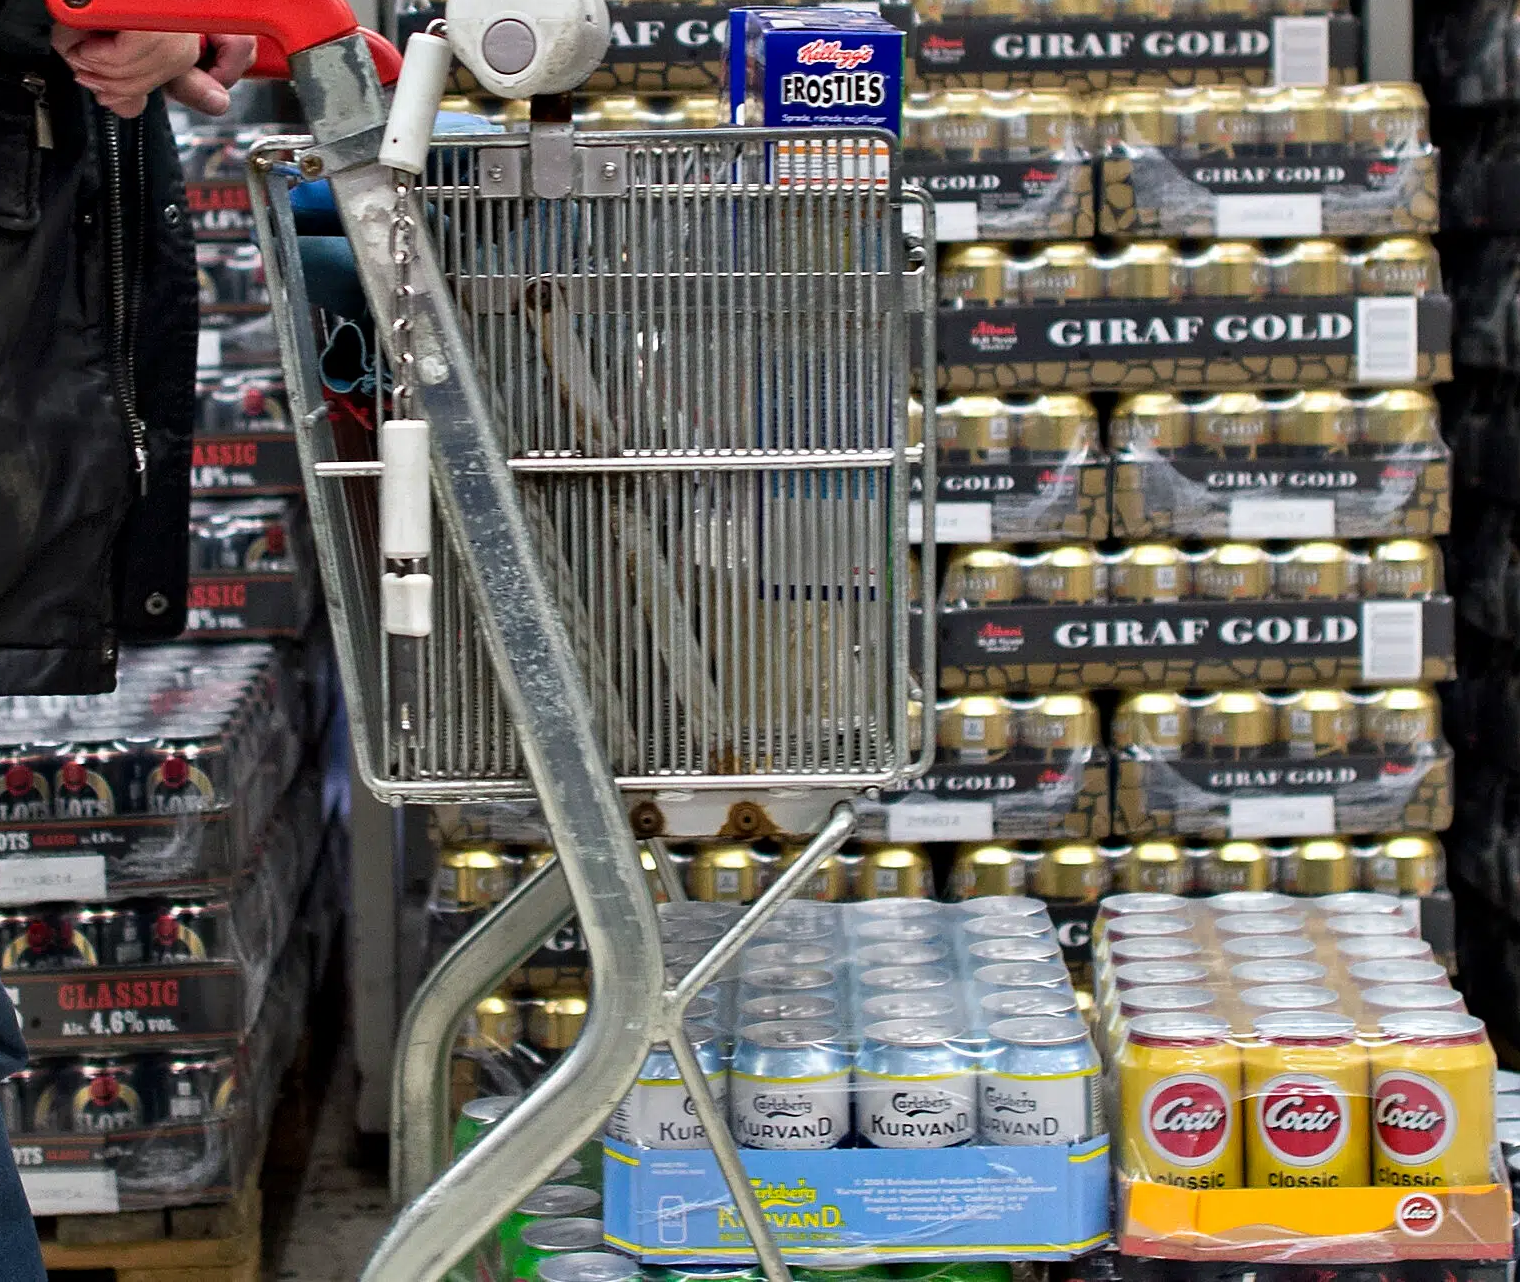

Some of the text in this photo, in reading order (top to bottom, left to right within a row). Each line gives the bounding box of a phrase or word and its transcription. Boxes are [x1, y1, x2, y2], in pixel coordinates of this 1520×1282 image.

[797, 40, 874, 70] Kellogg's
[992, 29, 1269, 60] GIRAF GOLD
[782, 73, 885, 108] FROSTIES
[934, 174, 1000, 191] GOLD
[1195, 166, 1345, 184] GIRAF GOLD
[1048, 317, 1204, 347] GIRAF
[1214, 313, 1353, 342] GOLD
[945, 474, 1015, 491] GOLD
[1207, 470, 1357, 489] GIRAF GOLD
[1055, 619, 1210, 648] GIRAF
[1219, 617, 1357, 645] GOLD
[952, 774, 1016, 791] GOLD
[1210, 767, 1357, 787] GIRAF GOLD
[57, 980, 179, 1010] CLASSIC
[89, 1010, 145, 1036] 4.6%
[147, 1016, 179, 1034] VOL.
[753, 1093, 813, 1113] Carlsberg
[892, 1091, 952, 1112] Carlsberg
[1153, 1096, 1225, 1133] Cocio
[1264, 1096, 1339, 1132] Cocio
[1376, 1093, 1442, 1132] Cocio
[871, 1113, 970, 1136] KURVAND
